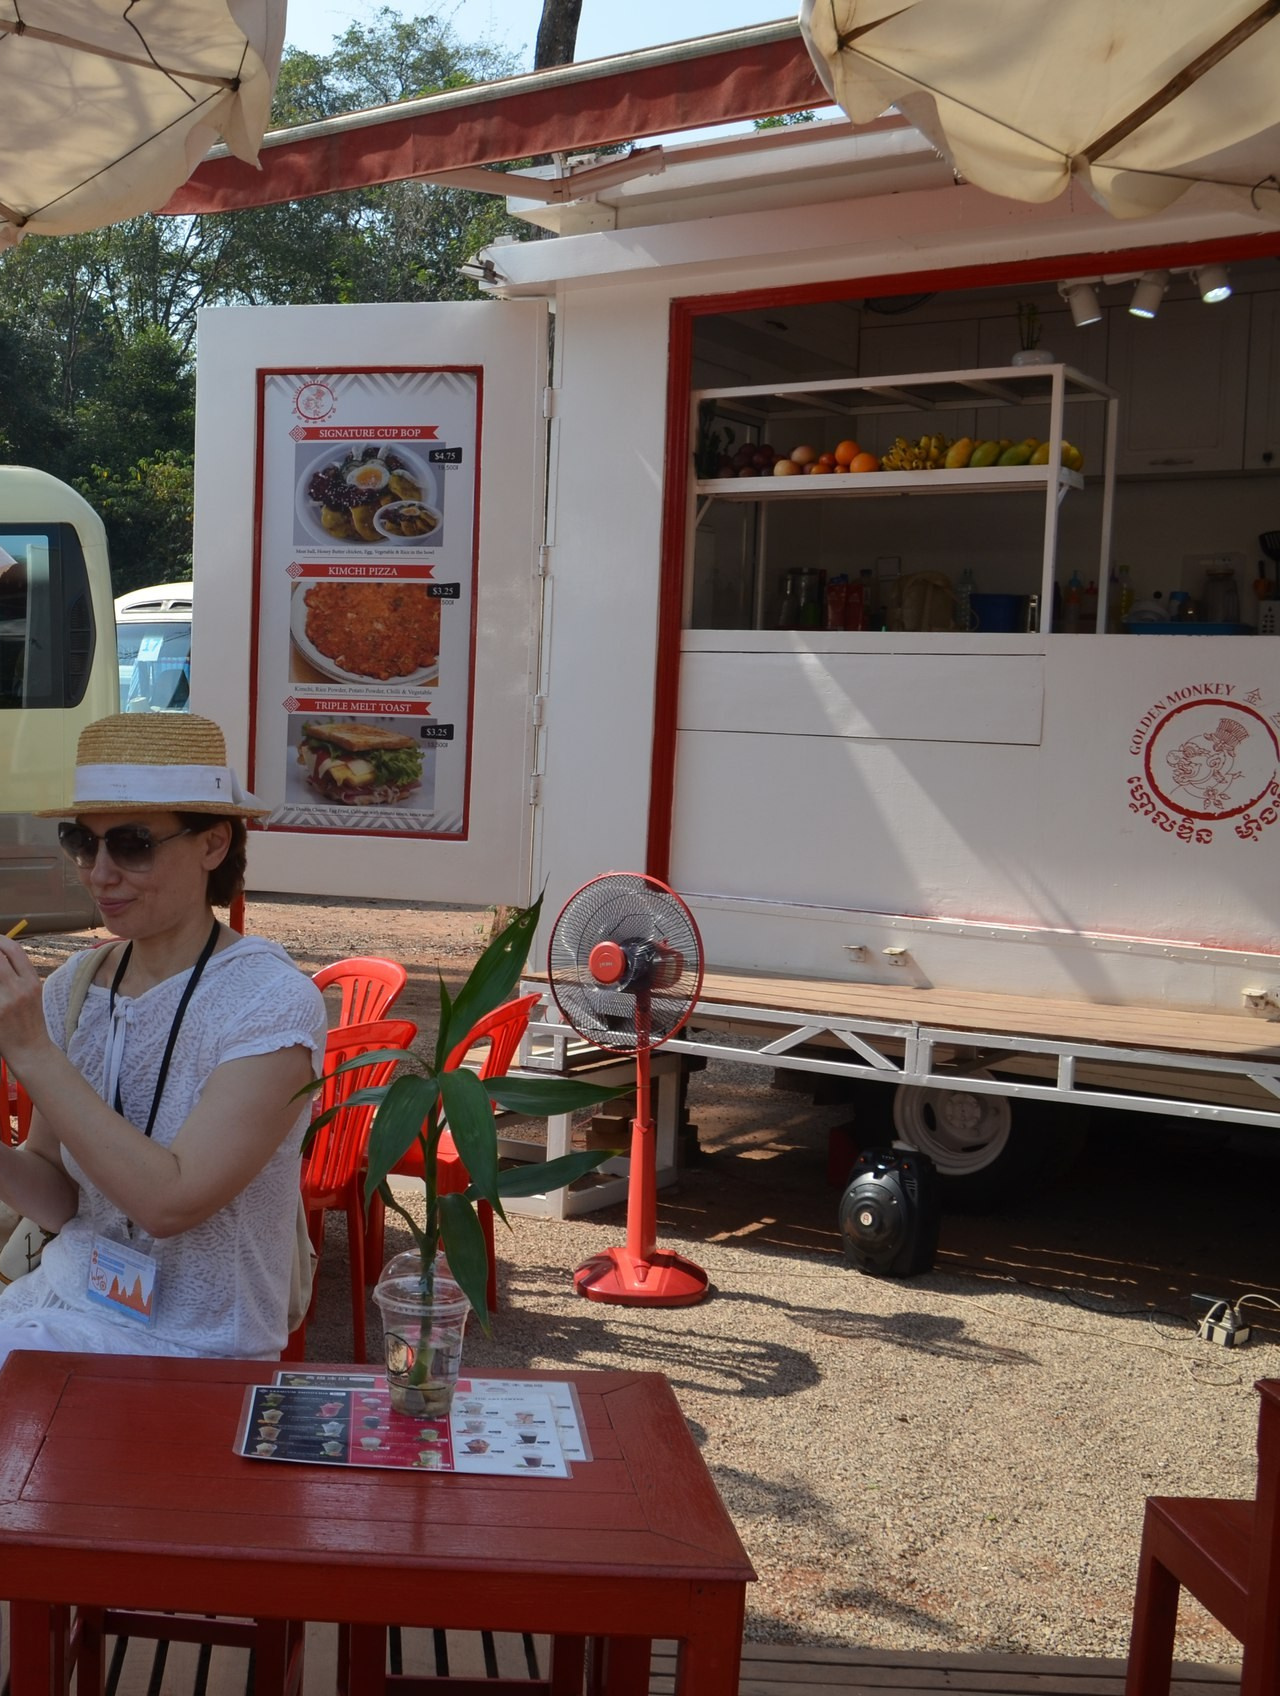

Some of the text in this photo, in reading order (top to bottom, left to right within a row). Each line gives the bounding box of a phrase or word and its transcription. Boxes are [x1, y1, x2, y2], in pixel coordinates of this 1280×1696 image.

[319, 428, 421, 438] SIGNATURE CUP BOP
[434, 451, 456, 461] $4.75
[328, 566, 398, 576] KIMCHI PIZZA
[432, 586, 454, 596] $3.25
[142, 639, 161, 653] 17
[314, 701, 412, 712] TRIPLE MELT TOAST
[1129, 682, 1237, 755] GOLDEN MONKEY
[426, 727, 448, 737] $3.25
